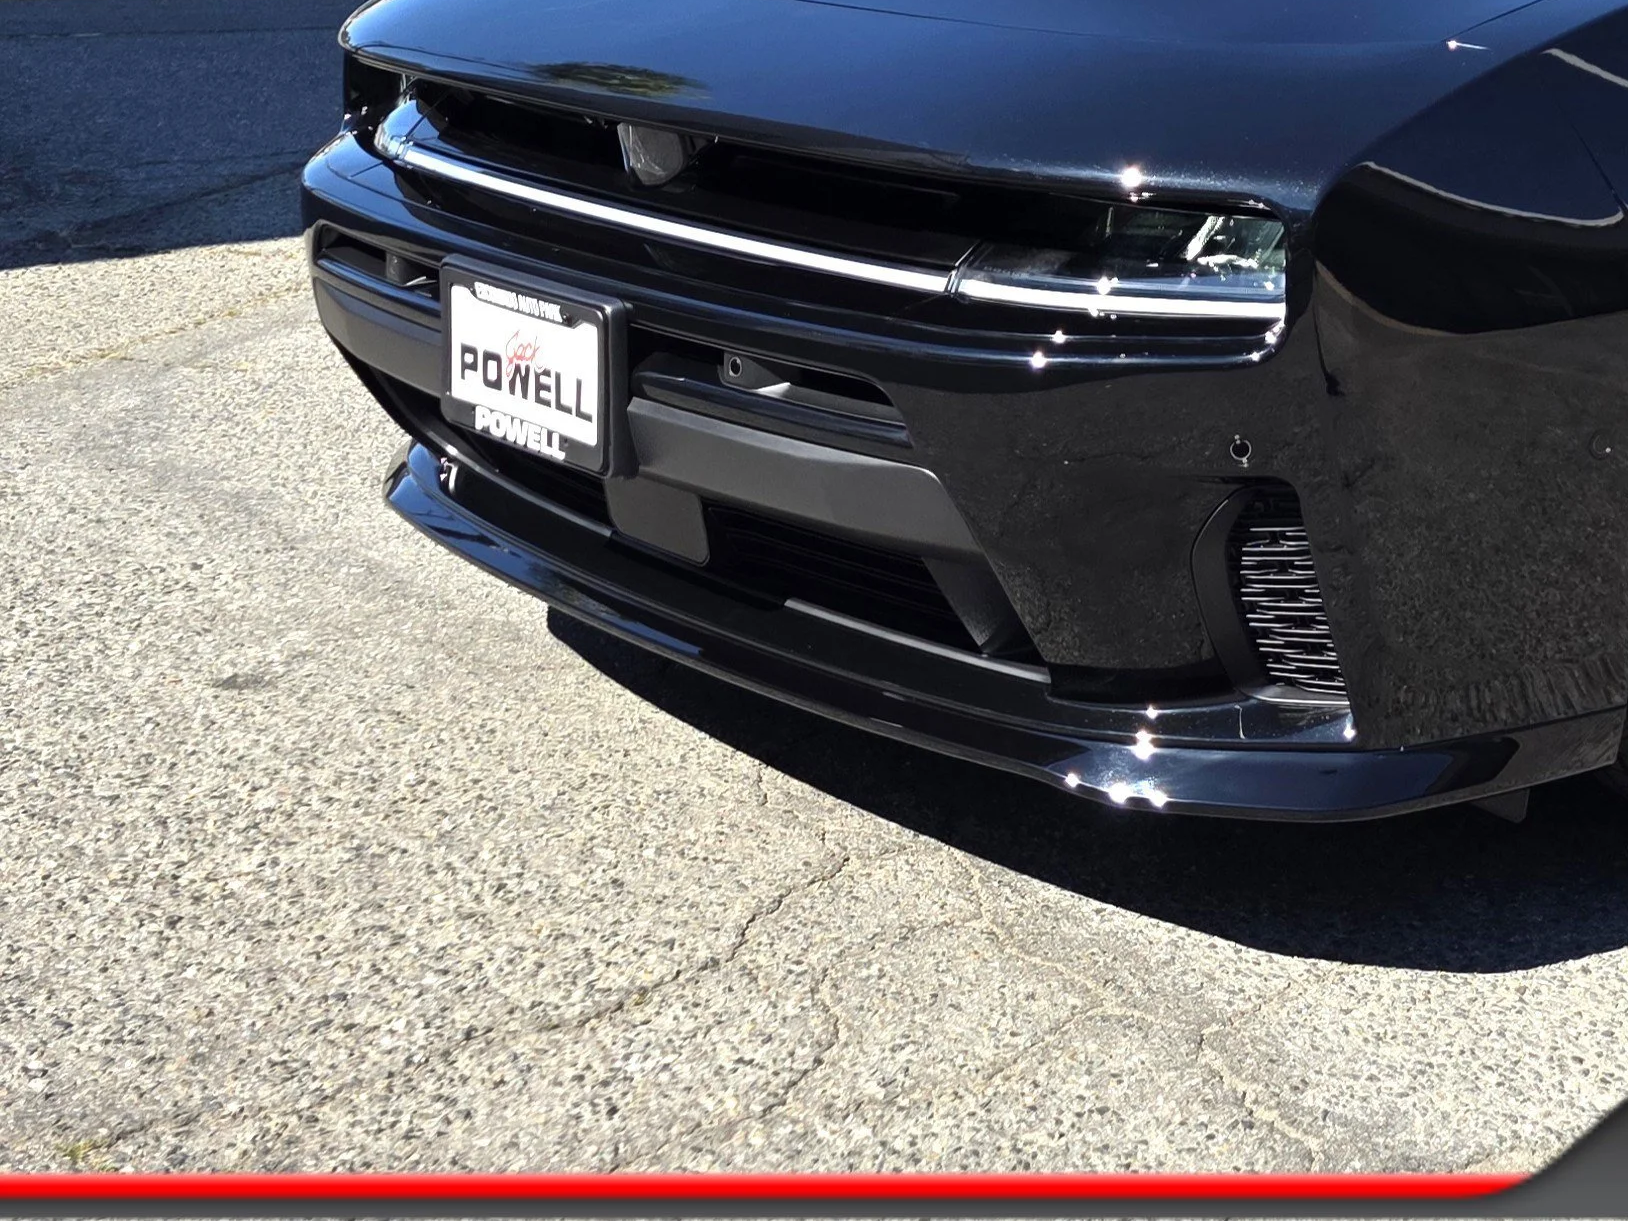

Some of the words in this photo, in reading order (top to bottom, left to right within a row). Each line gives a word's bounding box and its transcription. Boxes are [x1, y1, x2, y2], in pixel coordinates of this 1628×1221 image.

[506, 330, 545, 377] Jack
[461, 342, 593, 424] POWELL
[474, 405, 566, 461] POWELL
